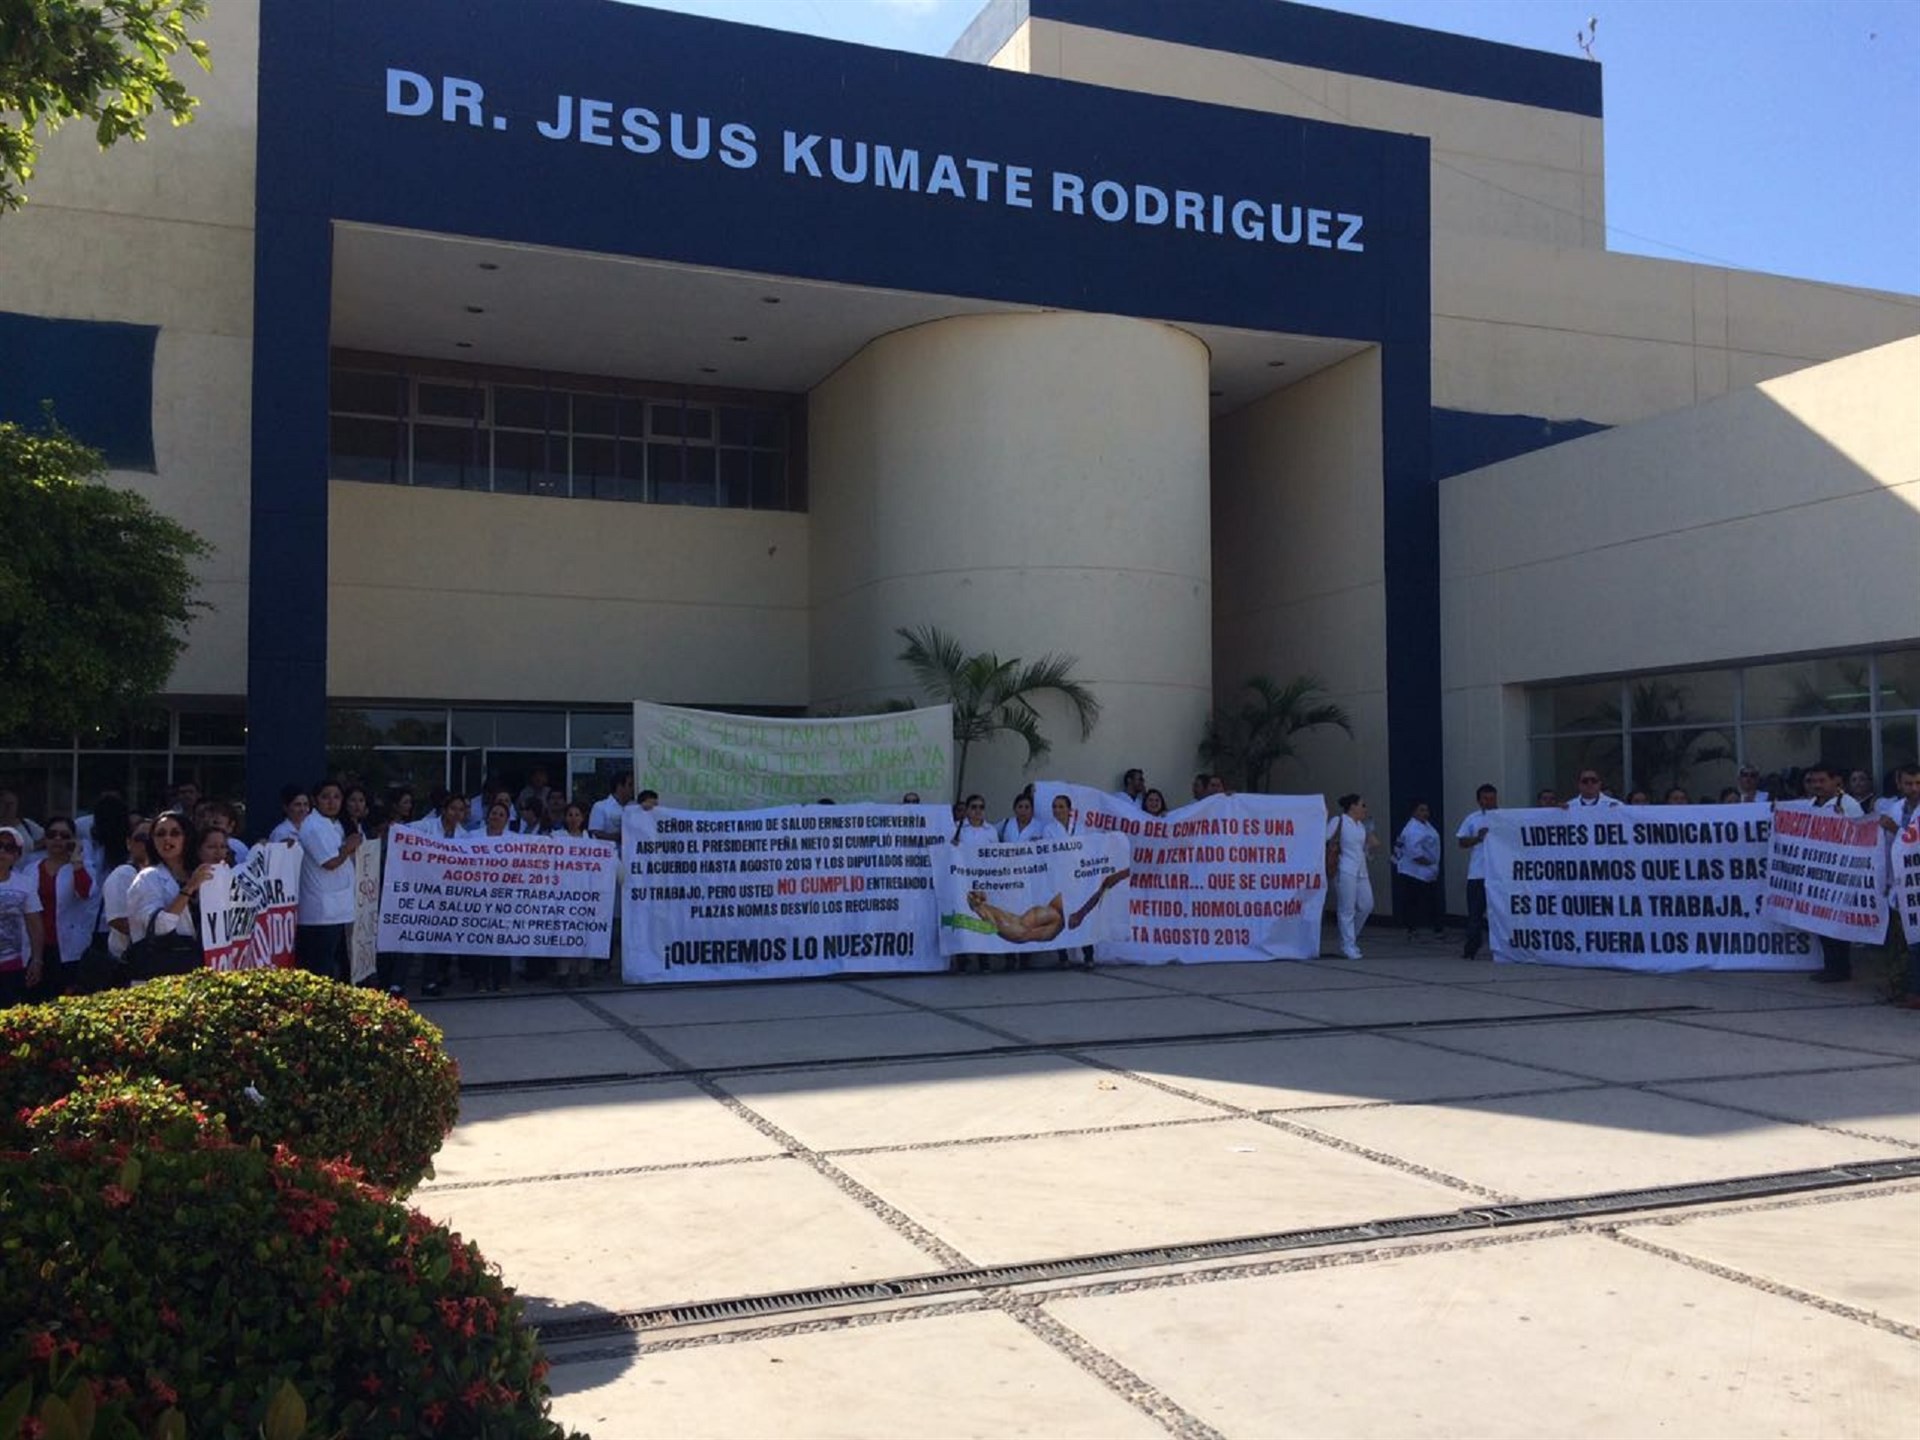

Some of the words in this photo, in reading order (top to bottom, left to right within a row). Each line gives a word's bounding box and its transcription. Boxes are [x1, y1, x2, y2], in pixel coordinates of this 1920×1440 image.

[386, 67, 506, 130] DR.
[537, 95, 758, 170] JESUS
[783, 129, 1033, 208] KUMATE
[1052, 171, 1364, 252] RODRIGUEZ
[657, 818, 693, 833] SEÑOR
[696, 819, 763, 833] SECRETARIO
[766, 819, 778, 831] DE
[781, 817, 816, 830] SALUD
[819, 816, 864, 830] ERNESTO
[1085, 811, 1140, 836] SUELDO
[1144, 821, 1168, 838] DEL
[1173, 818, 1239, 838] CONTRATO
[1243, 819, 1260, 835] ES
[1265, 819, 1294, 836] UNA
[1520, 823, 1589, 847] LIDERES
[1594, 823, 1628, 846] DEL
[1633, 821, 1739, 844] SINDICATO
[394, 833, 468, 854] PERSONAL
[472, 845, 490, 854] DE
[494, 844, 565, 856] CONTRATO
[569, 846, 612, 858] EXIGE
[636, 840, 684, 854] AISPURO
[688, 840, 700, 853] EL
[703, 839, 768, 853] PRESIDENTE
[771, 836, 798, 851] PEÑA
[801, 837, 830, 850] NIETO
[833, 836, 843, 848] SI
[1036, 845, 1050, 855] DE
[1052, 841, 1083, 851] SALUD
[402, 851, 421, 862] LO
[427, 853, 509, 868] PROMETIDO
[512, 859, 550, 870] BASES
[554, 860, 602, 872] HASTA
[631, 862, 643, 874] EL
[647, 860, 697, 874] ACUERDO
[701, 860, 737, 873] HASTA
[740, 858, 782, 872] AGOSTO
[786, 857, 812, 871] 2013
[816, 857, 821, 868] Y
[824, 856, 844, 869] LOS
[847, 855, 903, 868] DIPUTADOS
[1133, 848, 1153, 864] UN
[1156, 847, 1225, 864] ATENTADO
[1229, 847, 1286, 863] CONTRA
[443, 870, 499, 883] AGOSTO
[502, 873, 525, 884] DEL
[529, 874, 560, 886] 2013
[1013, 863, 1048, 875] estatal
[1513, 859, 1637, 882] RECORDAMOS
[1641, 859, 1680, 881] QUE
[1685, 858, 1725, 881] LAS
[1730, 858, 1768, 881] BAS
[394, 882, 409, 893] ES
[414, 883, 442, 895] UNA
[445, 885, 488, 898] BURLA
[490, 888, 513, 899] SER
[517, 889, 600, 901] TRABAJADOR
[631, 887, 647, 900] SU
[649, 886, 705, 900] TRABAJO,
[708, 886, 736, 899] PERO
[739, 884, 773, 898] USTED
[778, 878, 796, 895] NO
[866, 877, 927, 890] ENTREGANDO
[1130, 873, 1204, 889] AMILIAR...
[1208, 874, 1235, 890] QUE
[1239, 874, 1257, 890] SE
[1261, 874, 1321, 890] CUMPLA
[398, 899, 414, 910] DE
[418, 899, 435, 910] LA
[439, 901, 481, 913] SALUD
[485, 903, 493, 913] Y
[495, 903, 511, 914] NO
[515, 904, 565, 916] CONTAR
[569, 905, 596, 917] CON
[691, 905, 735, 918] PLAZAS
[737, 903, 778, 917] NOMAS
[822, 900, 842, 913] LOS
[845, 898, 899, 913] RECURSOS
[1510, 895, 1531, 915] ES
[1536, 896, 1560, 916] DE
[1562, 895, 1614, 917] QUIEN
[1620, 896, 1643, 917] LA
[1648, 895, 1750, 919] TRABAJA,
[207, 912, 217, 944] Y
[383, 913, 458, 927] SEGURIDAD
[513, 920, 526, 930] NI
[398, 930, 451, 942] ALGUNA
[455, 932, 464, 943] Y
[466, 933, 494, 944] CON
[497, 934, 530, 945] BAJO
[1131, 926, 1149, 943] TA
[1154, 928, 1210, 945] AGOSTO
[1214, 929, 1250, 946] 2013
[1510, 929, 1581, 955] JUSTOS,
[1585, 931, 1645, 954] FUERA
[1651, 932, 1689, 954] LOS
[1696, 932, 1811, 955] AVIADORES
[665, 938, 787, 970] ¡QUEREMOS
[793, 936, 818, 961] LO
[823, 932, 914, 959] NUESTRO!
